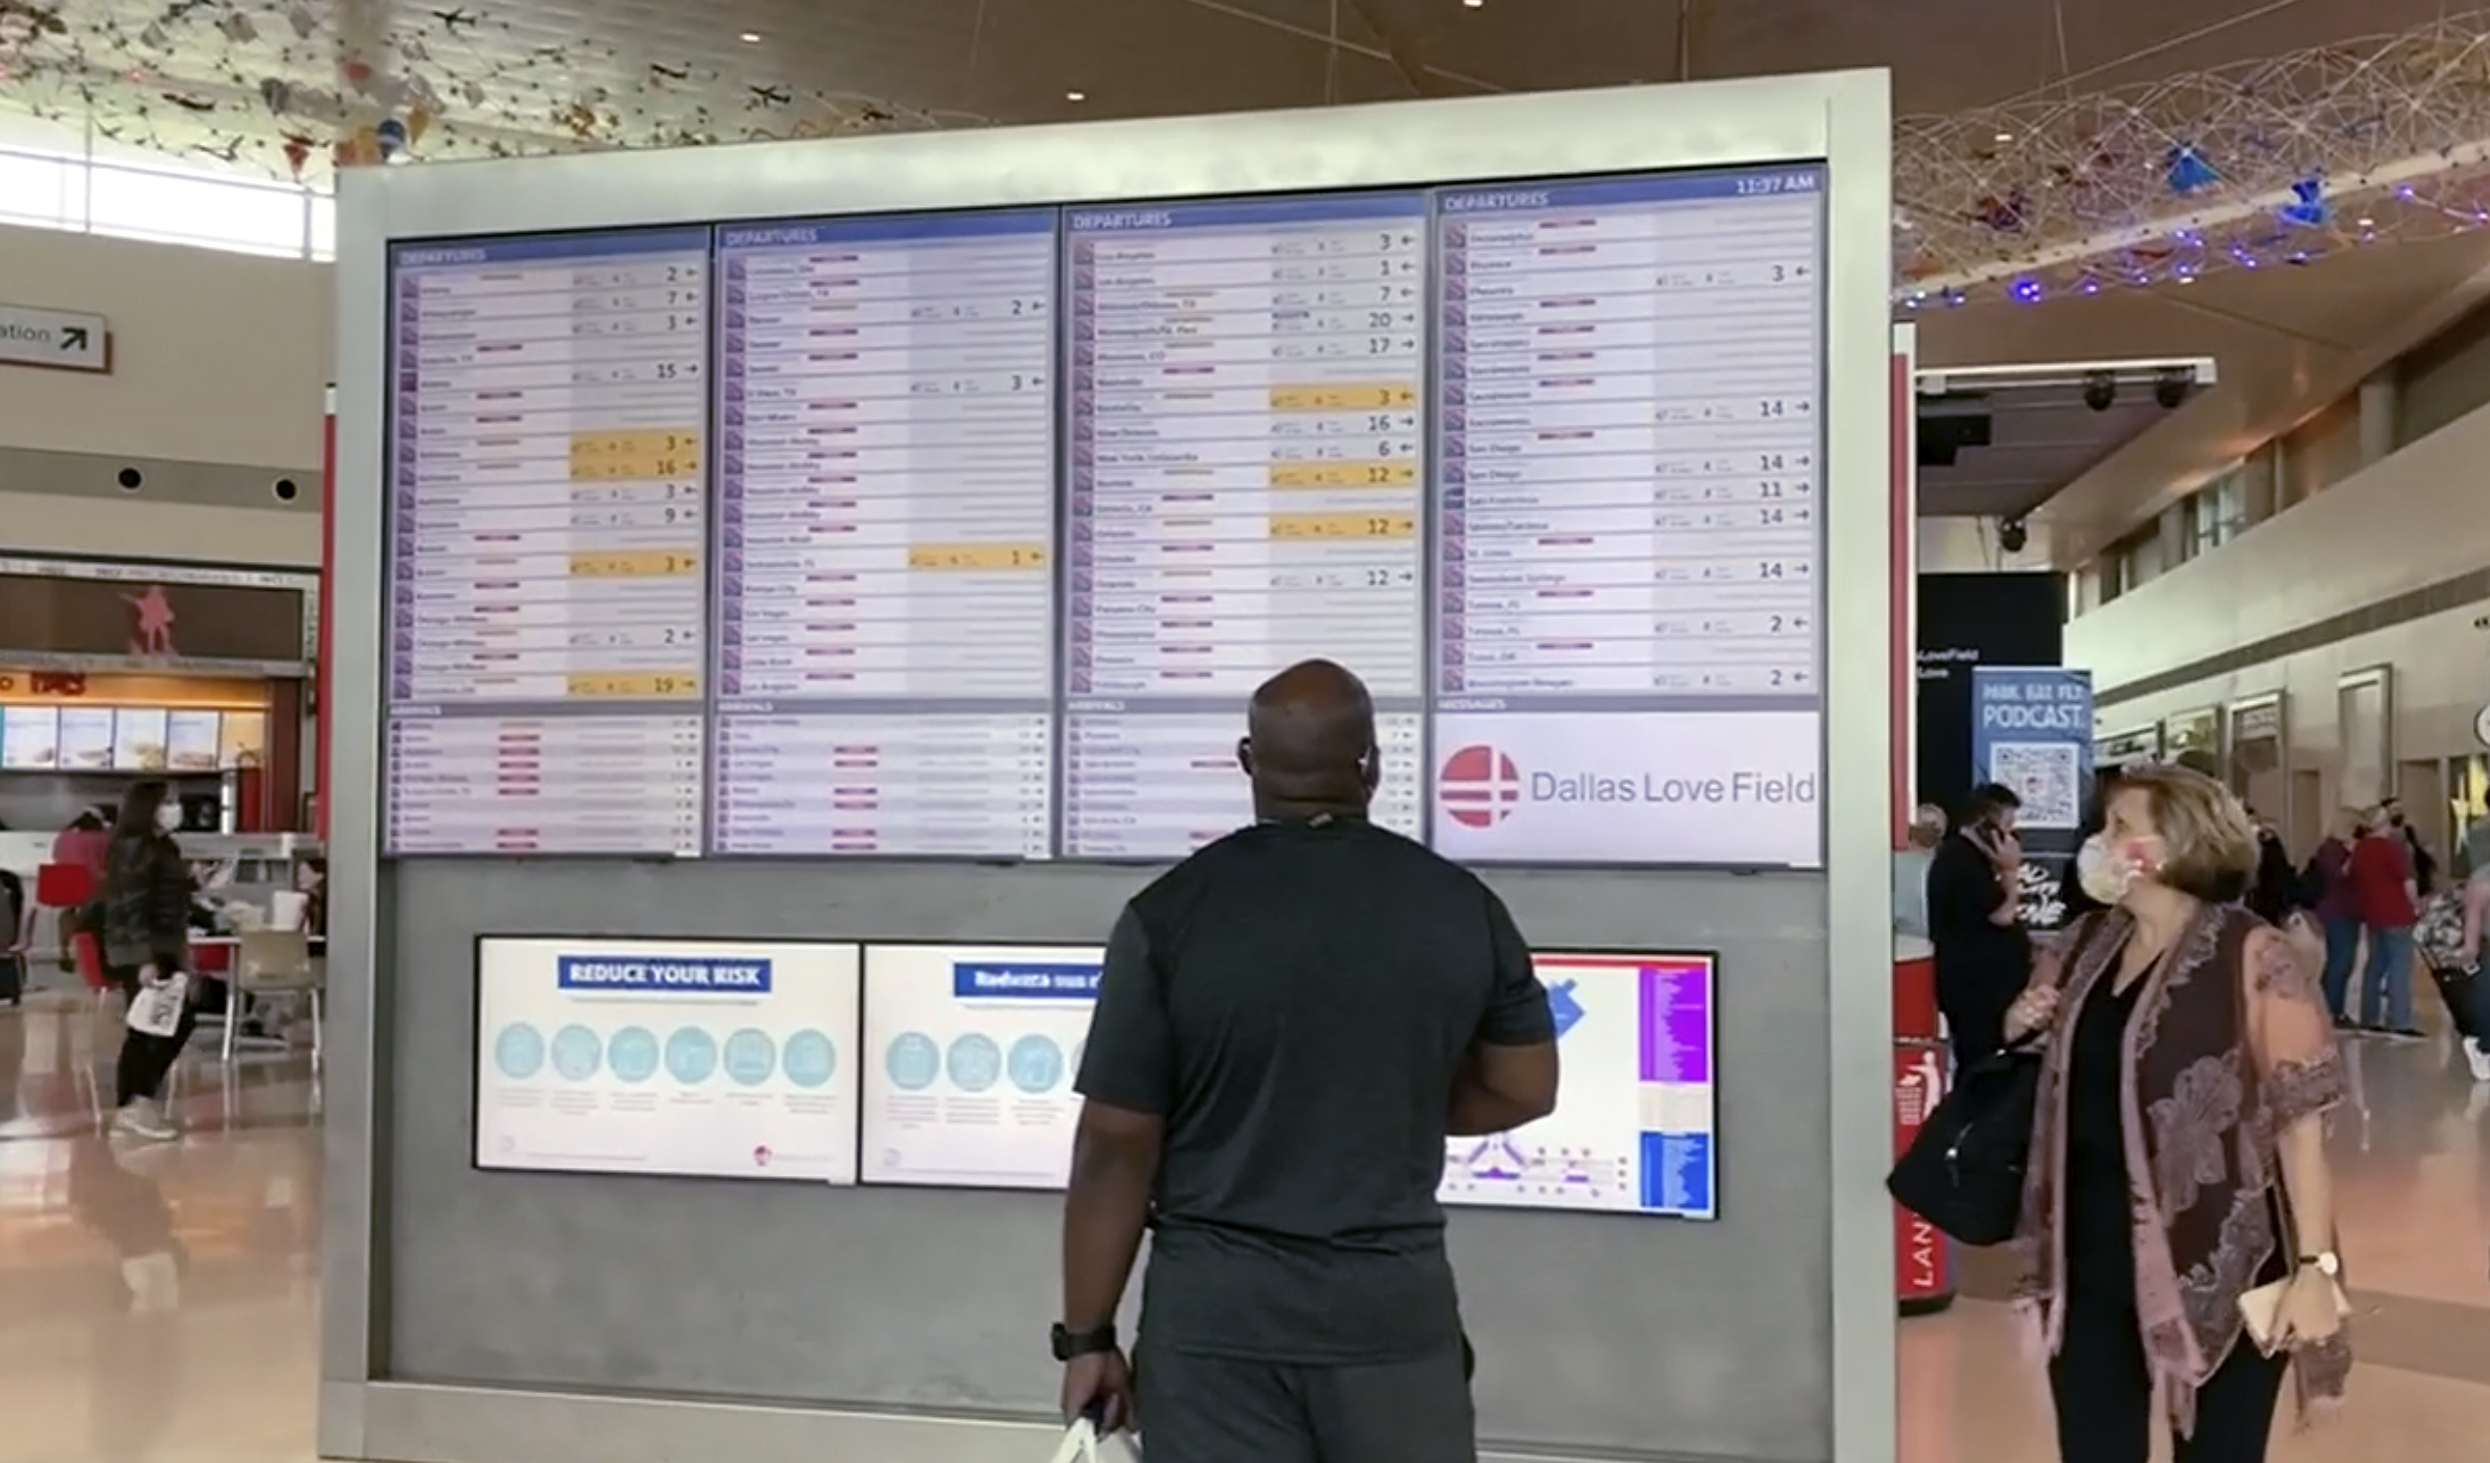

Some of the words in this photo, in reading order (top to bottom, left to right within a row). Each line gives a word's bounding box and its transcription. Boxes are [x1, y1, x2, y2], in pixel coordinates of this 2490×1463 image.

[1787, 175, 1815, 190] AM
[1073, 213, 1172, 229] DEPARTURES
[1379, 234, 1391, 249] 3
[667, 267, 677, 281] 2
[1772, 265, 1784, 281] 3
[667, 291, 677, 305] 7
[1379, 287, 1391, 301] 7
[1012, 301, 1022, 315] 2
[667, 315, 677, 330] 3
[1369, 313, 1392, 328] 20
[1369, 339, 1391, 354] 17
[657, 363, 677, 378] 15
[1011, 375, 1022, 391] 3
[1378, 390, 1390, 405] 3
[1760, 401, 1784, 416] 14
[1368, 416, 1391, 431] 16
[666, 436, 676, 451] 3
[1378, 441, 1391, 456] 6
[656, 460, 677, 475] 16
[1760, 455, 1784, 470] 14
[1367, 467, 1390, 482] 12
[665, 484, 675, 499] 3
[1760, 482, 1783, 497] 11
[665, 508, 676, 522] 9
[1760, 509, 1784, 524] 14
[1367, 518, 1390, 534] 12
[1367, 570, 1389, 586] 12
[1760, 563, 1784, 578] 14
[1770, 616, 1783, 632] 2
[664, 629, 674, 643] 2
[1770, 670, 1783, 686] 2
[1531, 771, 1636, 803] Dallas
[1644, 773, 1724, 803] Love
[1731, 771, 1815, 803] Field
[569, 963, 647, 982] REDUCE
[651, 964, 708, 983] YOUR
[712, 966, 762, 986] RISK
[1912, 1213, 1934, 1288] LAN
